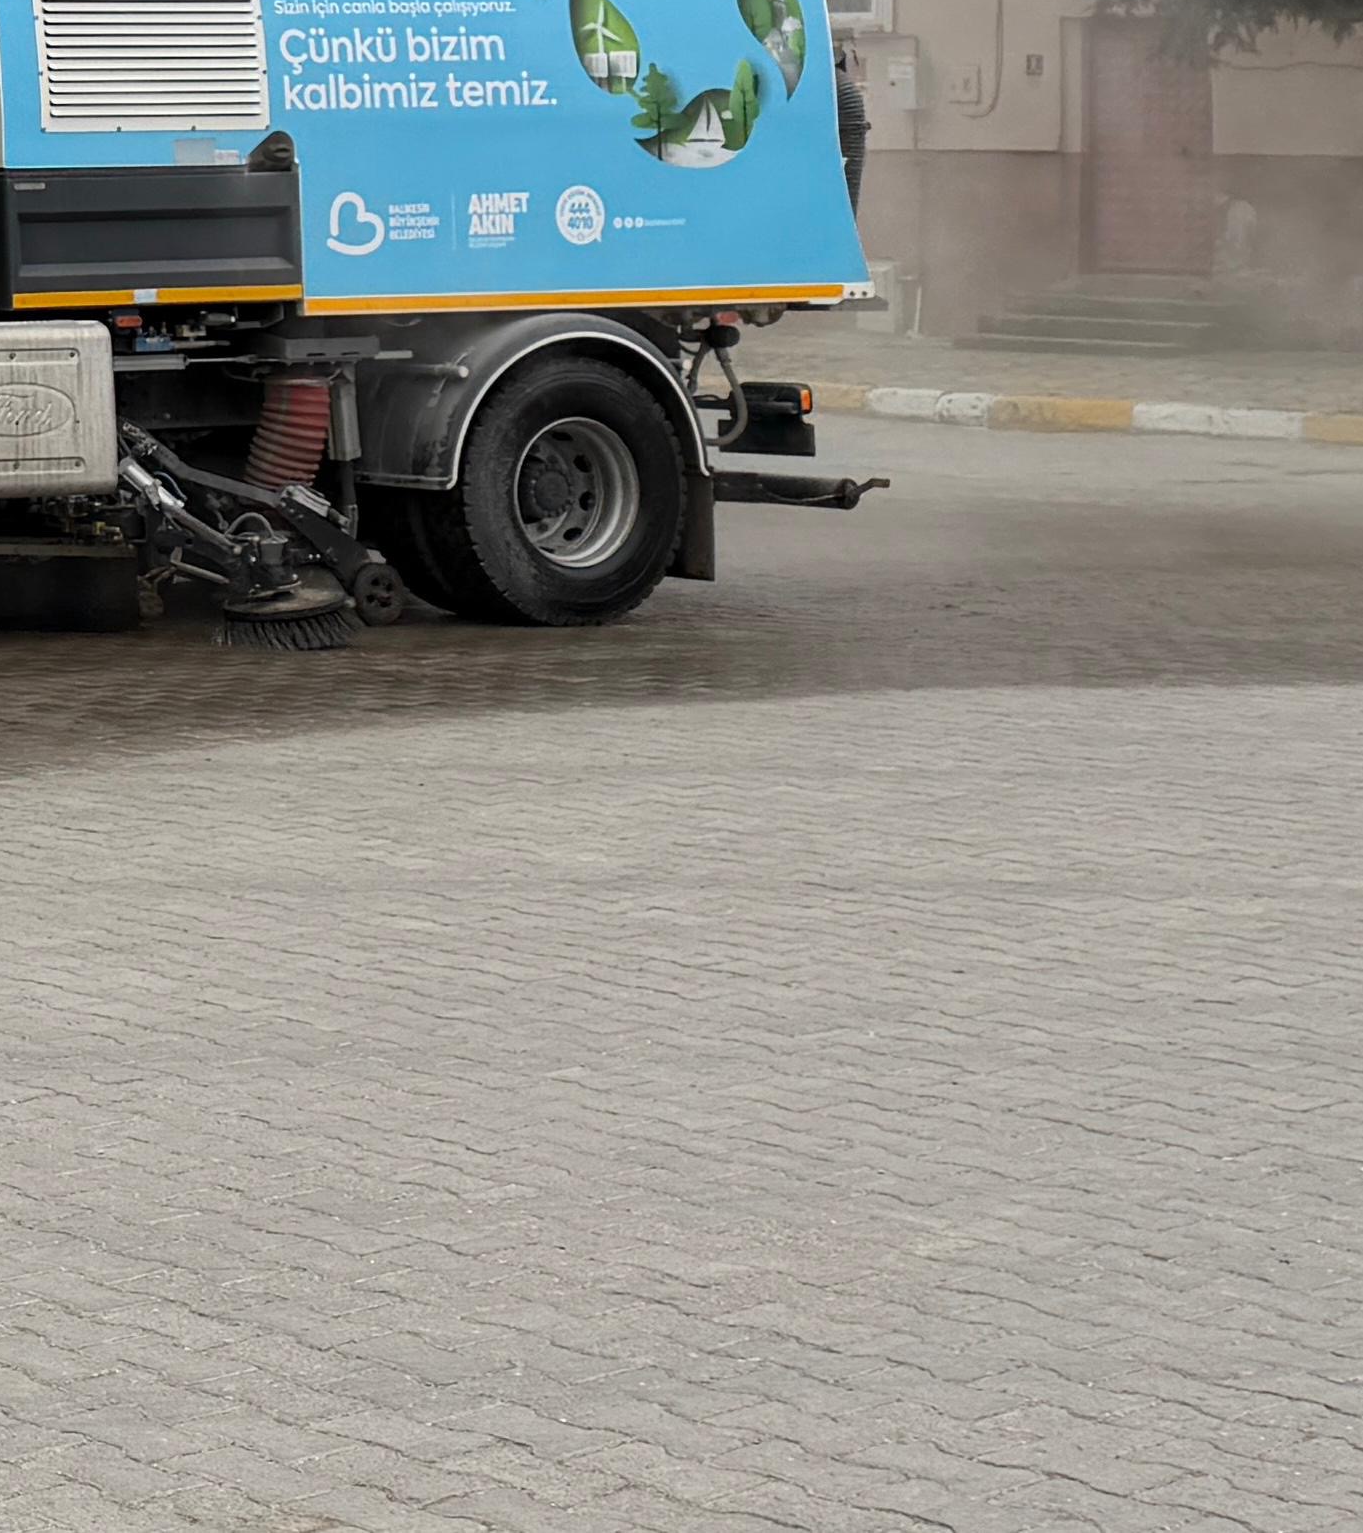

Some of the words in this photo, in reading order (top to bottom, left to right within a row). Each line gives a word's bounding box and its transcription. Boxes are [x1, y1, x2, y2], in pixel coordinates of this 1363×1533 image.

[273, 0, 310, 15] Sizin
[342, 0, 385, 15] canla
[279, 26, 399, 76] Çünkü
[406, 26, 506, 63] bizim
[283, 73, 440, 111] kalbimiz
[446, 70, 558, 108] temiz.
[468, 192, 530, 214] AHMET
[468, 213, 515, 235] AKIN
